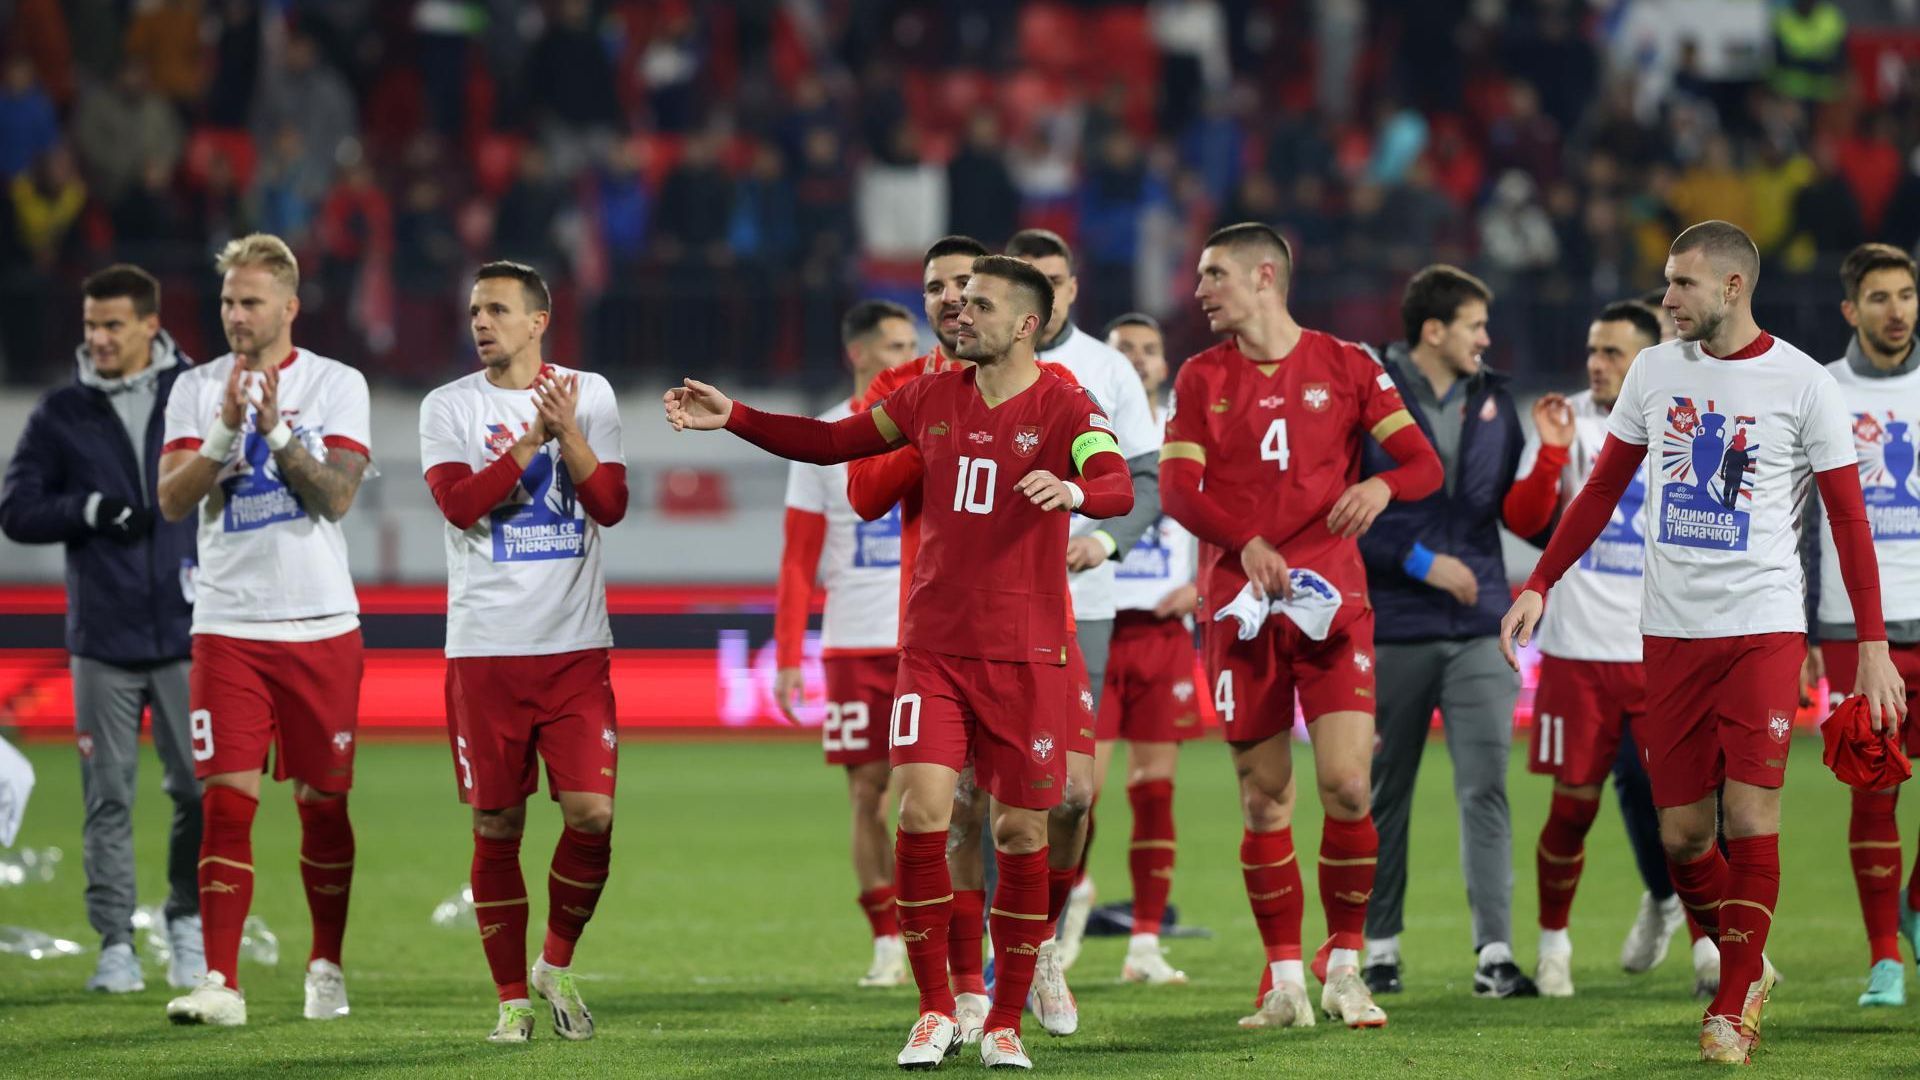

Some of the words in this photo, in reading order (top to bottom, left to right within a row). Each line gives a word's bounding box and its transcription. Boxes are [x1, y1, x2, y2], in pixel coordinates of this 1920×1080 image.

[1260, 418, 1290, 471] 4
[953, 455, 998, 515] 10
[503, 524, 558, 539] Видимо
[560, 522, 576, 535] се
[1667, 503, 1715, 524] Видимо
[1718, 513, 1734, 525] се
[1667, 523, 1673, 540] у
[1674, 520, 1740, 547] Немачкој!
[505, 543, 514, 559] у
[1215, 669, 1235, 722] 4
[191, 709, 215, 761] 9
[823, 701, 869, 751] 22
[1539, 713, 1564, 765] 11
